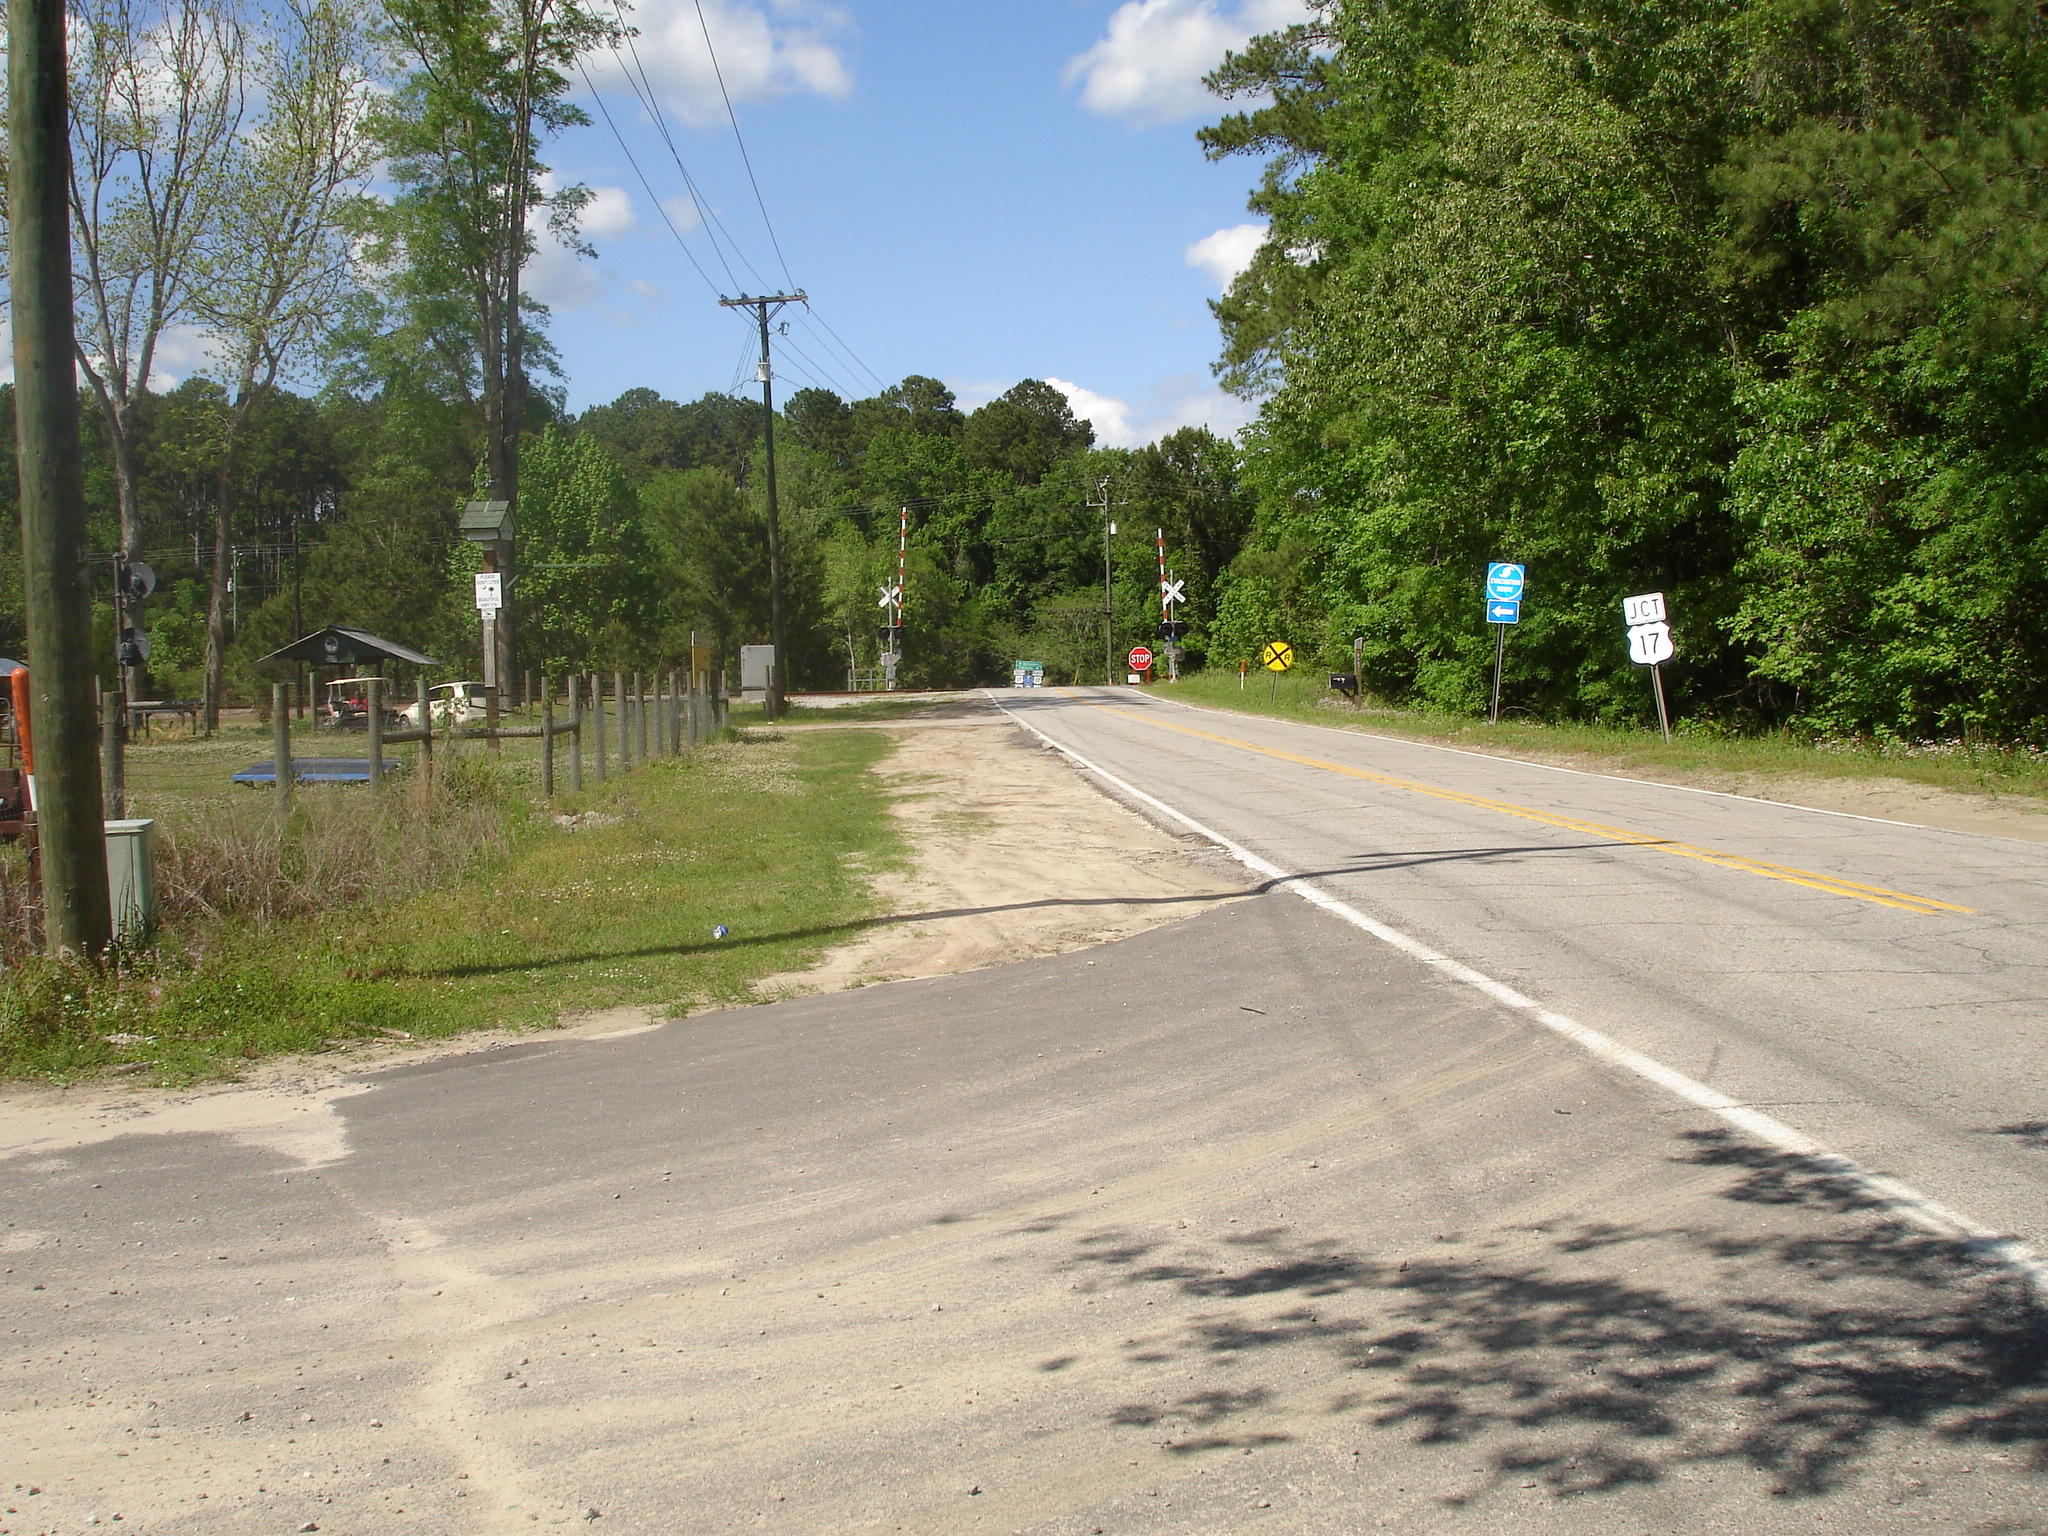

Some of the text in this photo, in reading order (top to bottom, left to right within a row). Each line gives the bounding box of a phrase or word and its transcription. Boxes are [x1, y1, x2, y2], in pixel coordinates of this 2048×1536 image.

[1630, 599, 1659, 619] JCT
[1640, 632, 1660, 656] 17
[1131, 654, 1150, 664] STOP
[1265, 651, 1291, 661] R R
